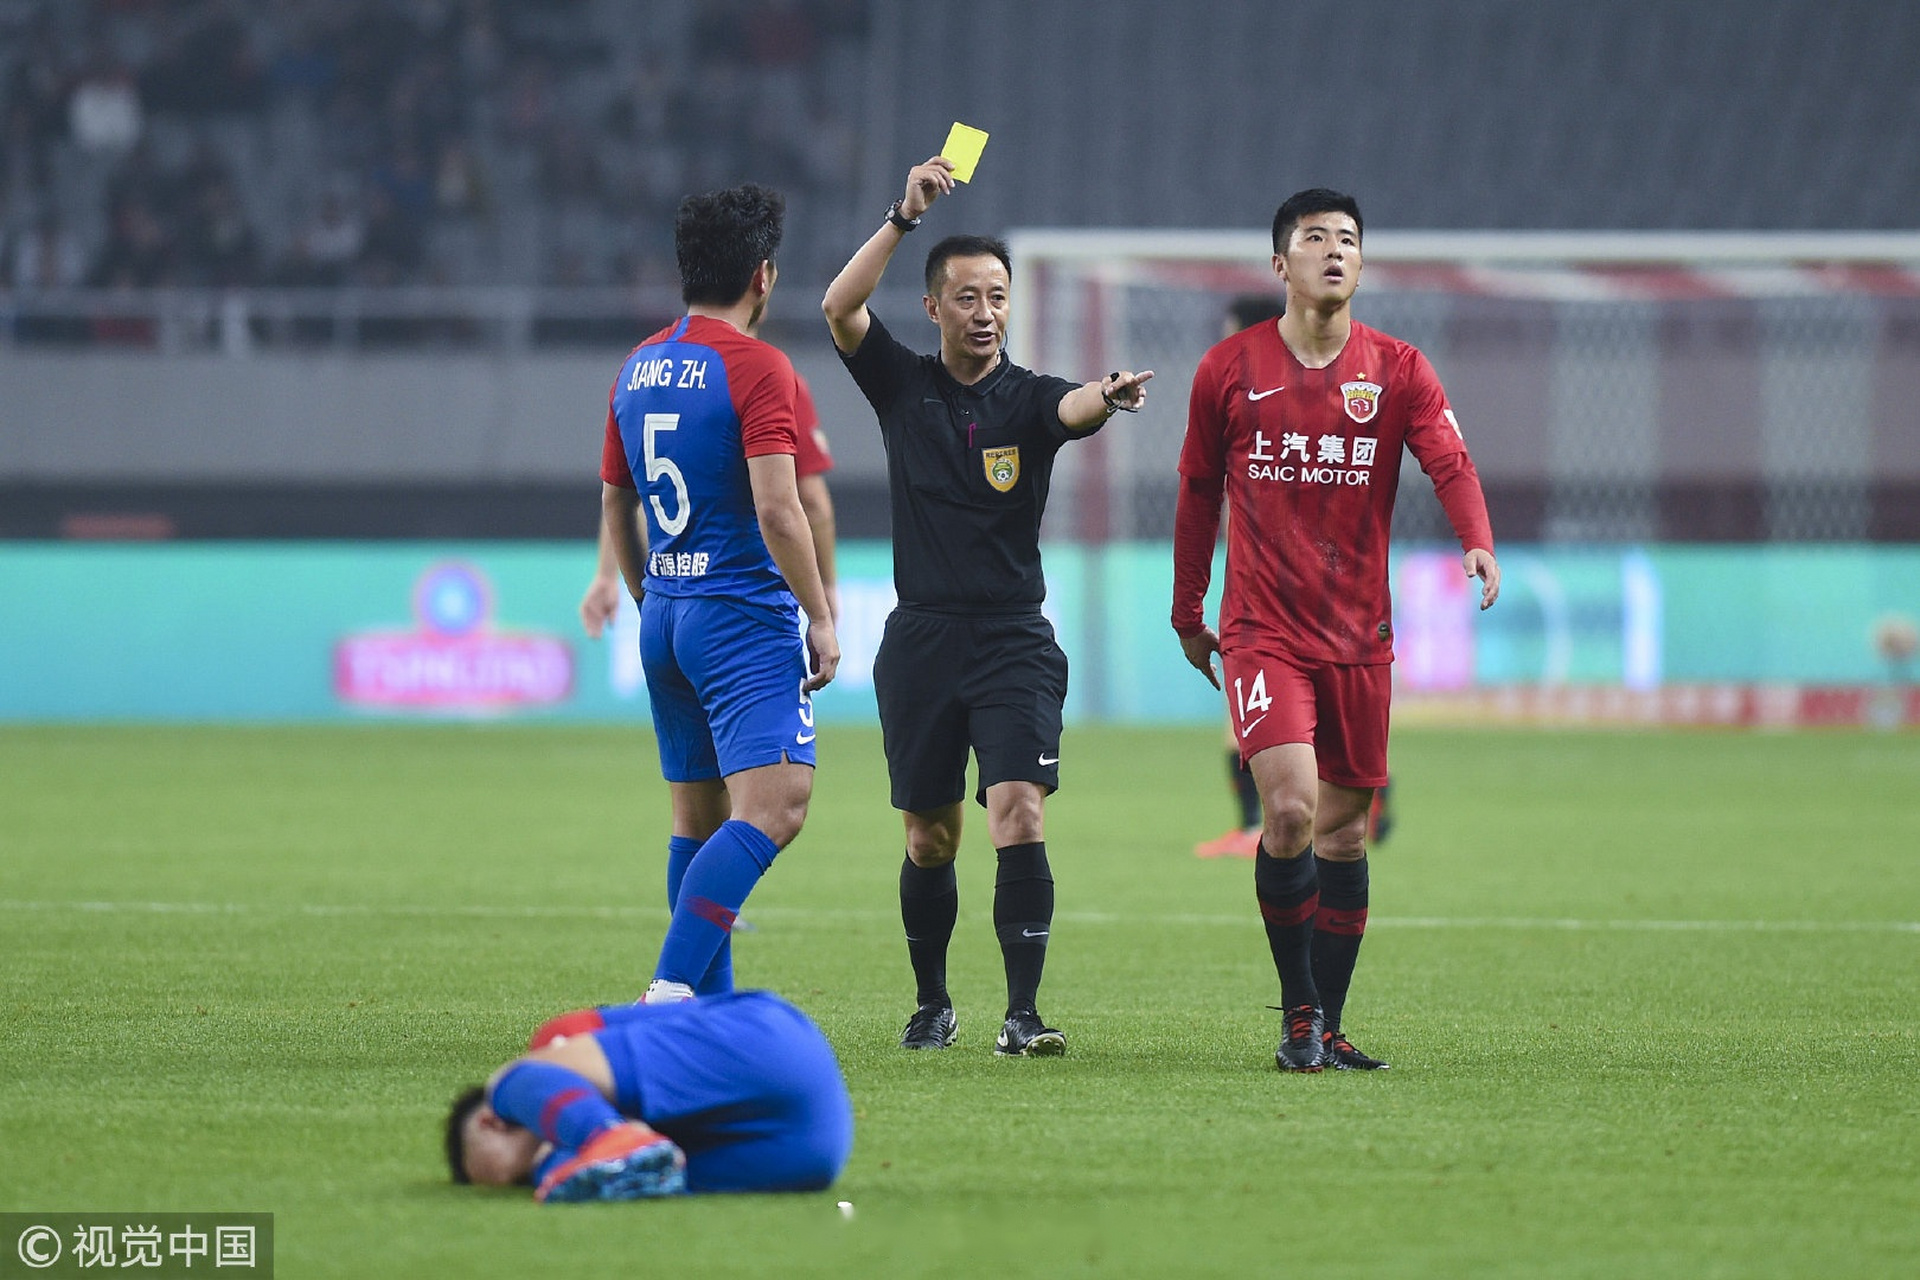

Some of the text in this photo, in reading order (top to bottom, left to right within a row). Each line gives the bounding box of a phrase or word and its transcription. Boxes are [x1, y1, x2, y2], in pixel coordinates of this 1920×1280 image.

[627, 358, 707, 391] JIANG ZH.
[1248, 430, 1378, 467] 上汽集团
[643, 413, 691, 536] 5
[1248, 463, 1370, 486] SAIC MOTOR
[1234, 668, 1273, 723] 14
